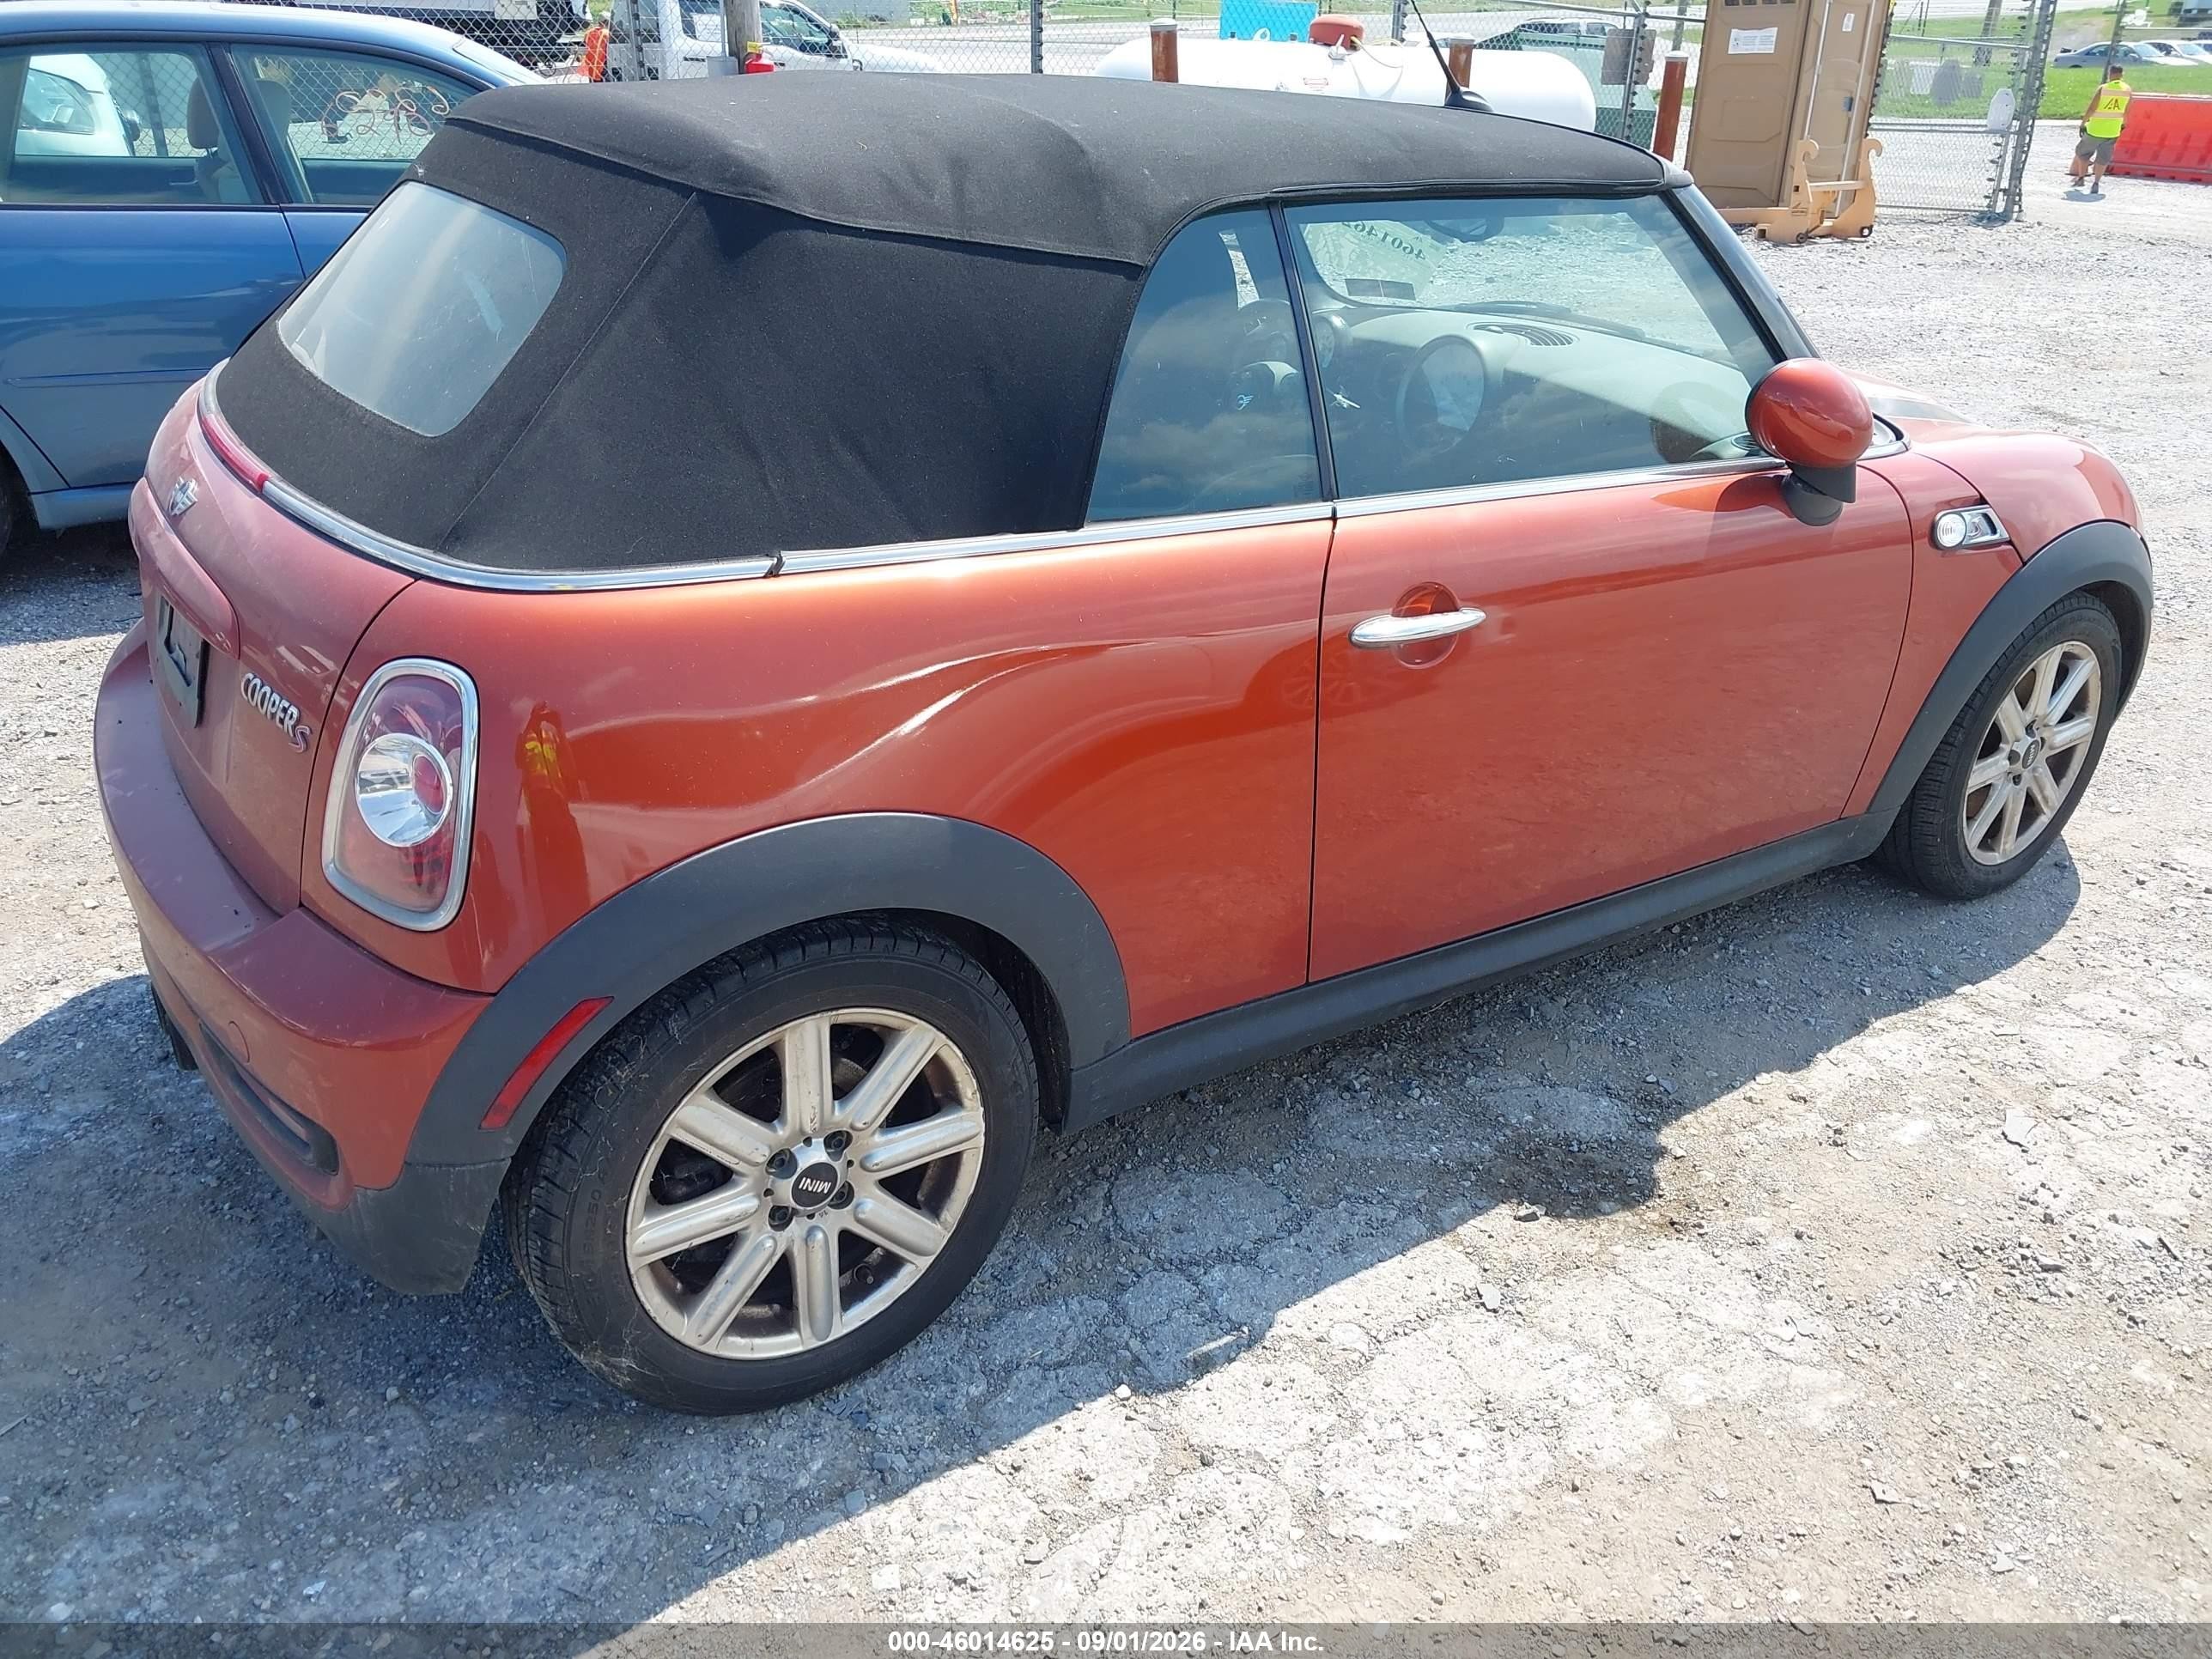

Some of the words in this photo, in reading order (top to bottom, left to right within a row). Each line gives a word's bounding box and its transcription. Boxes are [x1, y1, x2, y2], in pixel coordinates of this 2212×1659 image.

[240, 672, 300, 738] COOPER
[288, 725, 311, 753] S
[798, 1176, 832, 1194] MINI
